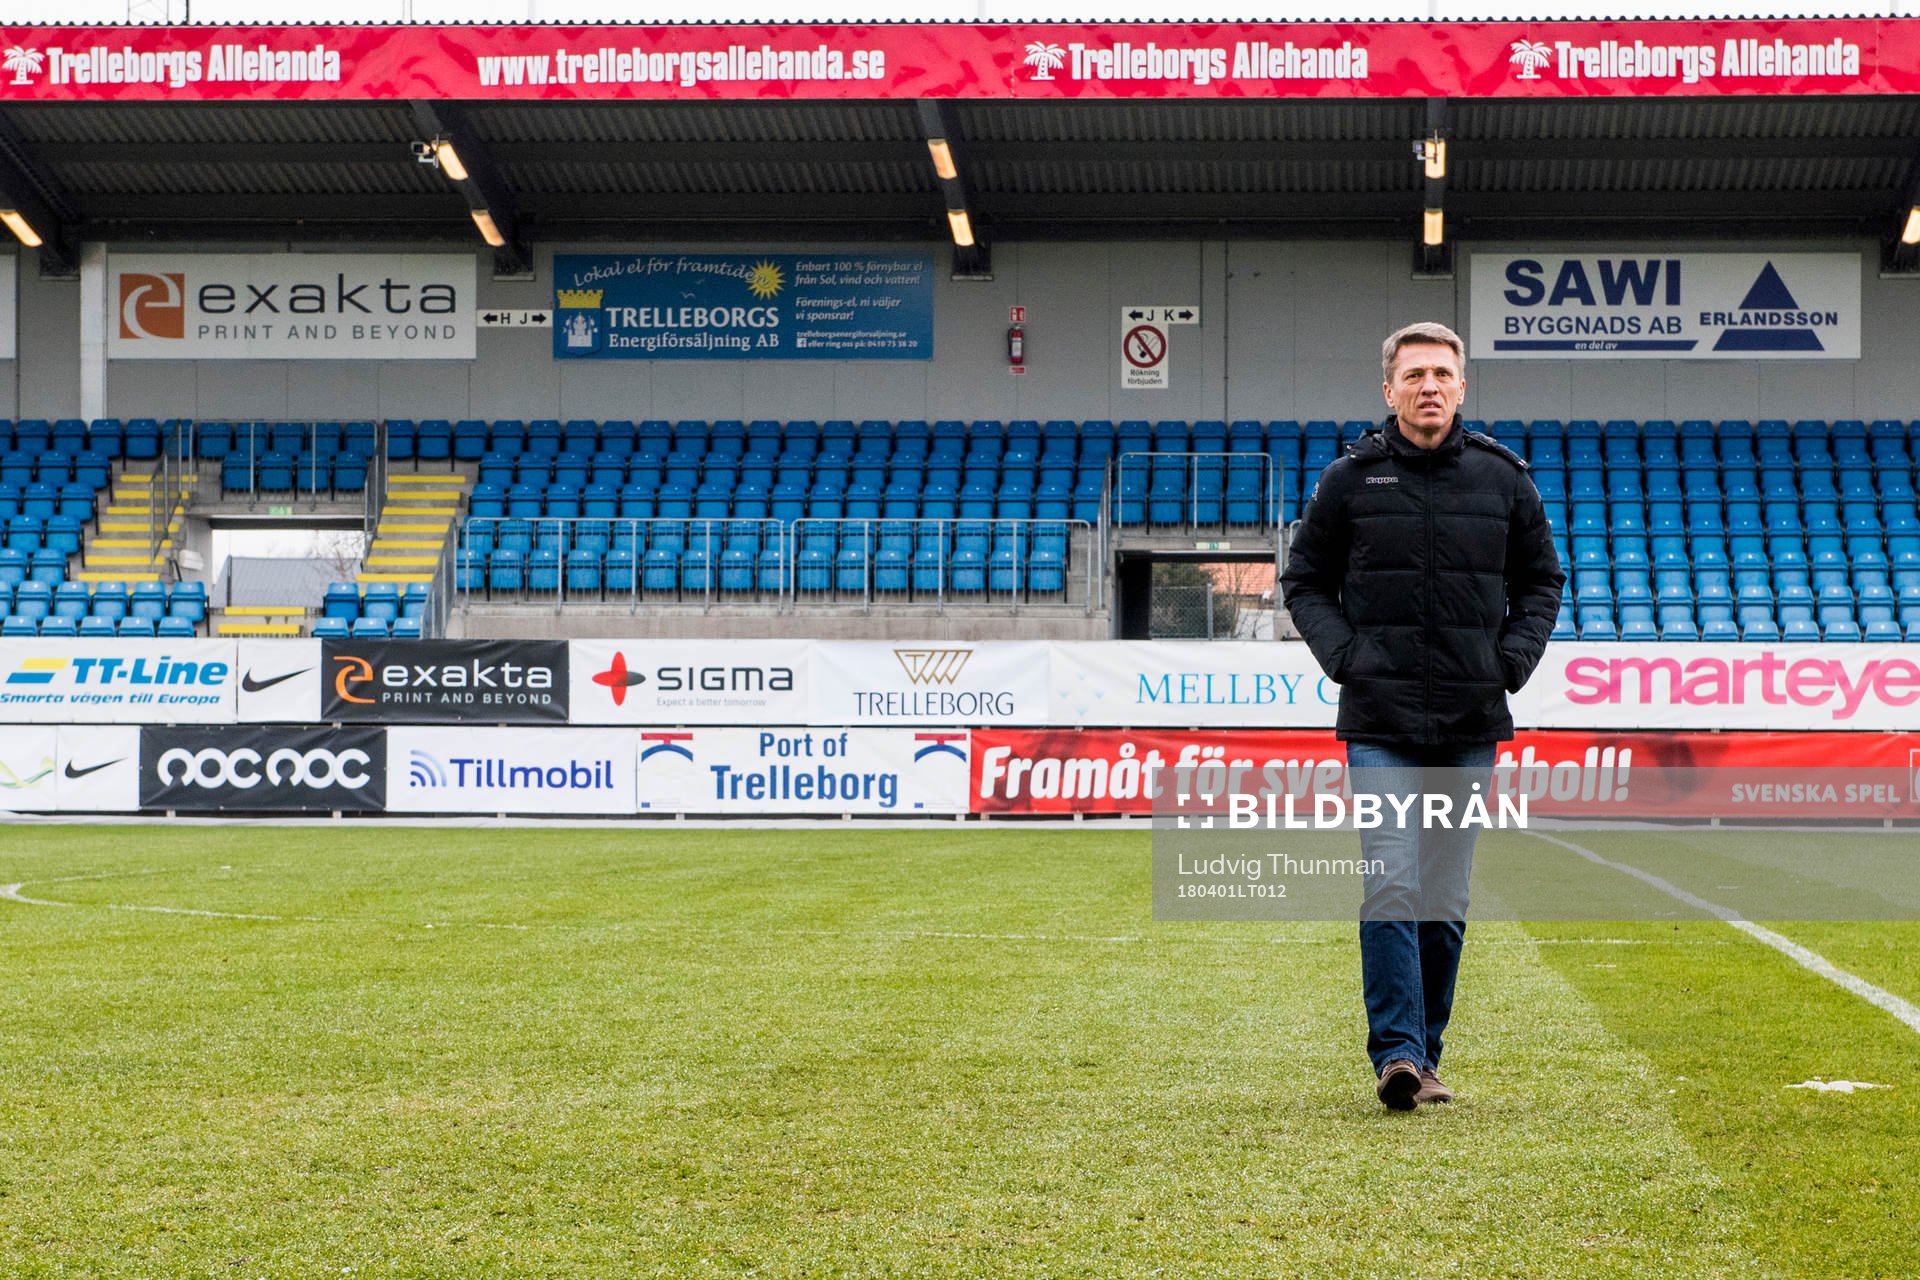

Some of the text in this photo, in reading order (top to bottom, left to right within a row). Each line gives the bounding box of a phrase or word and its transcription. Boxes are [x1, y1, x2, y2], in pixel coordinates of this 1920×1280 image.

[46, 44, 341, 88] Trelleborgs Allehanda
[477, 45, 886, 87] www.trelleborgsallehanda.se
[1068, 41, 1368, 85] Trelleborgs Allehanda
[1555, 37, 1860, 84] Trelleborgs Allehanda
[573, 261, 625, 287] Lokal
[627, 258, 643, 273] el
[647, 257, 673, 274] för
[795, 261, 830, 271] Enbart
[835, 261, 852, 271] 100
[865, 261, 910, 274] förnybar
[913, 261, 923, 271] el
[794, 274, 817, 287] från
[820, 274, 837, 286] Sol,
[840, 274, 862, 285] vind
[864, 274, 883, 285] och
[1503, 259, 1681, 306] SAWI
[199, 273, 457, 314] exakta
[860, 297, 870, 307] ni
[872, 296, 902, 309] väljer
[500, 313, 528, 325] H J
[605, 307, 780, 328] TRELLEBORGS
[795, 310, 854, 322] vi sponsrar!
[1146, 309, 1174, 321] J K
[1700, 312, 1838, 326] ERLANDSSON
[198, 325, 457, 340] PRINT AND BEYOND
[1504, 316, 1682, 335] BYGGNADS AB
[609, 333, 779, 351] Energiförsäljning AB
[1575, 340, 1618, 350] en del av
[1127, 377, 1162, 386] förbjuden
[1130, 368, 1160, 378] Rökning
[72, 656, 228, 685] TT-Line
[382, 658, 552, 688] exakta
[0, 692, 220, 705] Smarta vägen till Europa
[382, 692, 552, 704] PRINT AND BEYOND
[1136, 673, 1304, 705] MELLBY
[853, 692, 1014, 716] TRELLEBORG
[760, 732, 848, 757] Port of
[450, 758, 614, 789] Tillmobil
[980, 742, 1165, 799] Framåt
[1174, 744, 1253, 799] för
[1494, 746, 1632, 802] tboll!
[710, 765, 898, 808] Trelleborg
[1731, 783, 1900, 803] SVENSKA SPEL
